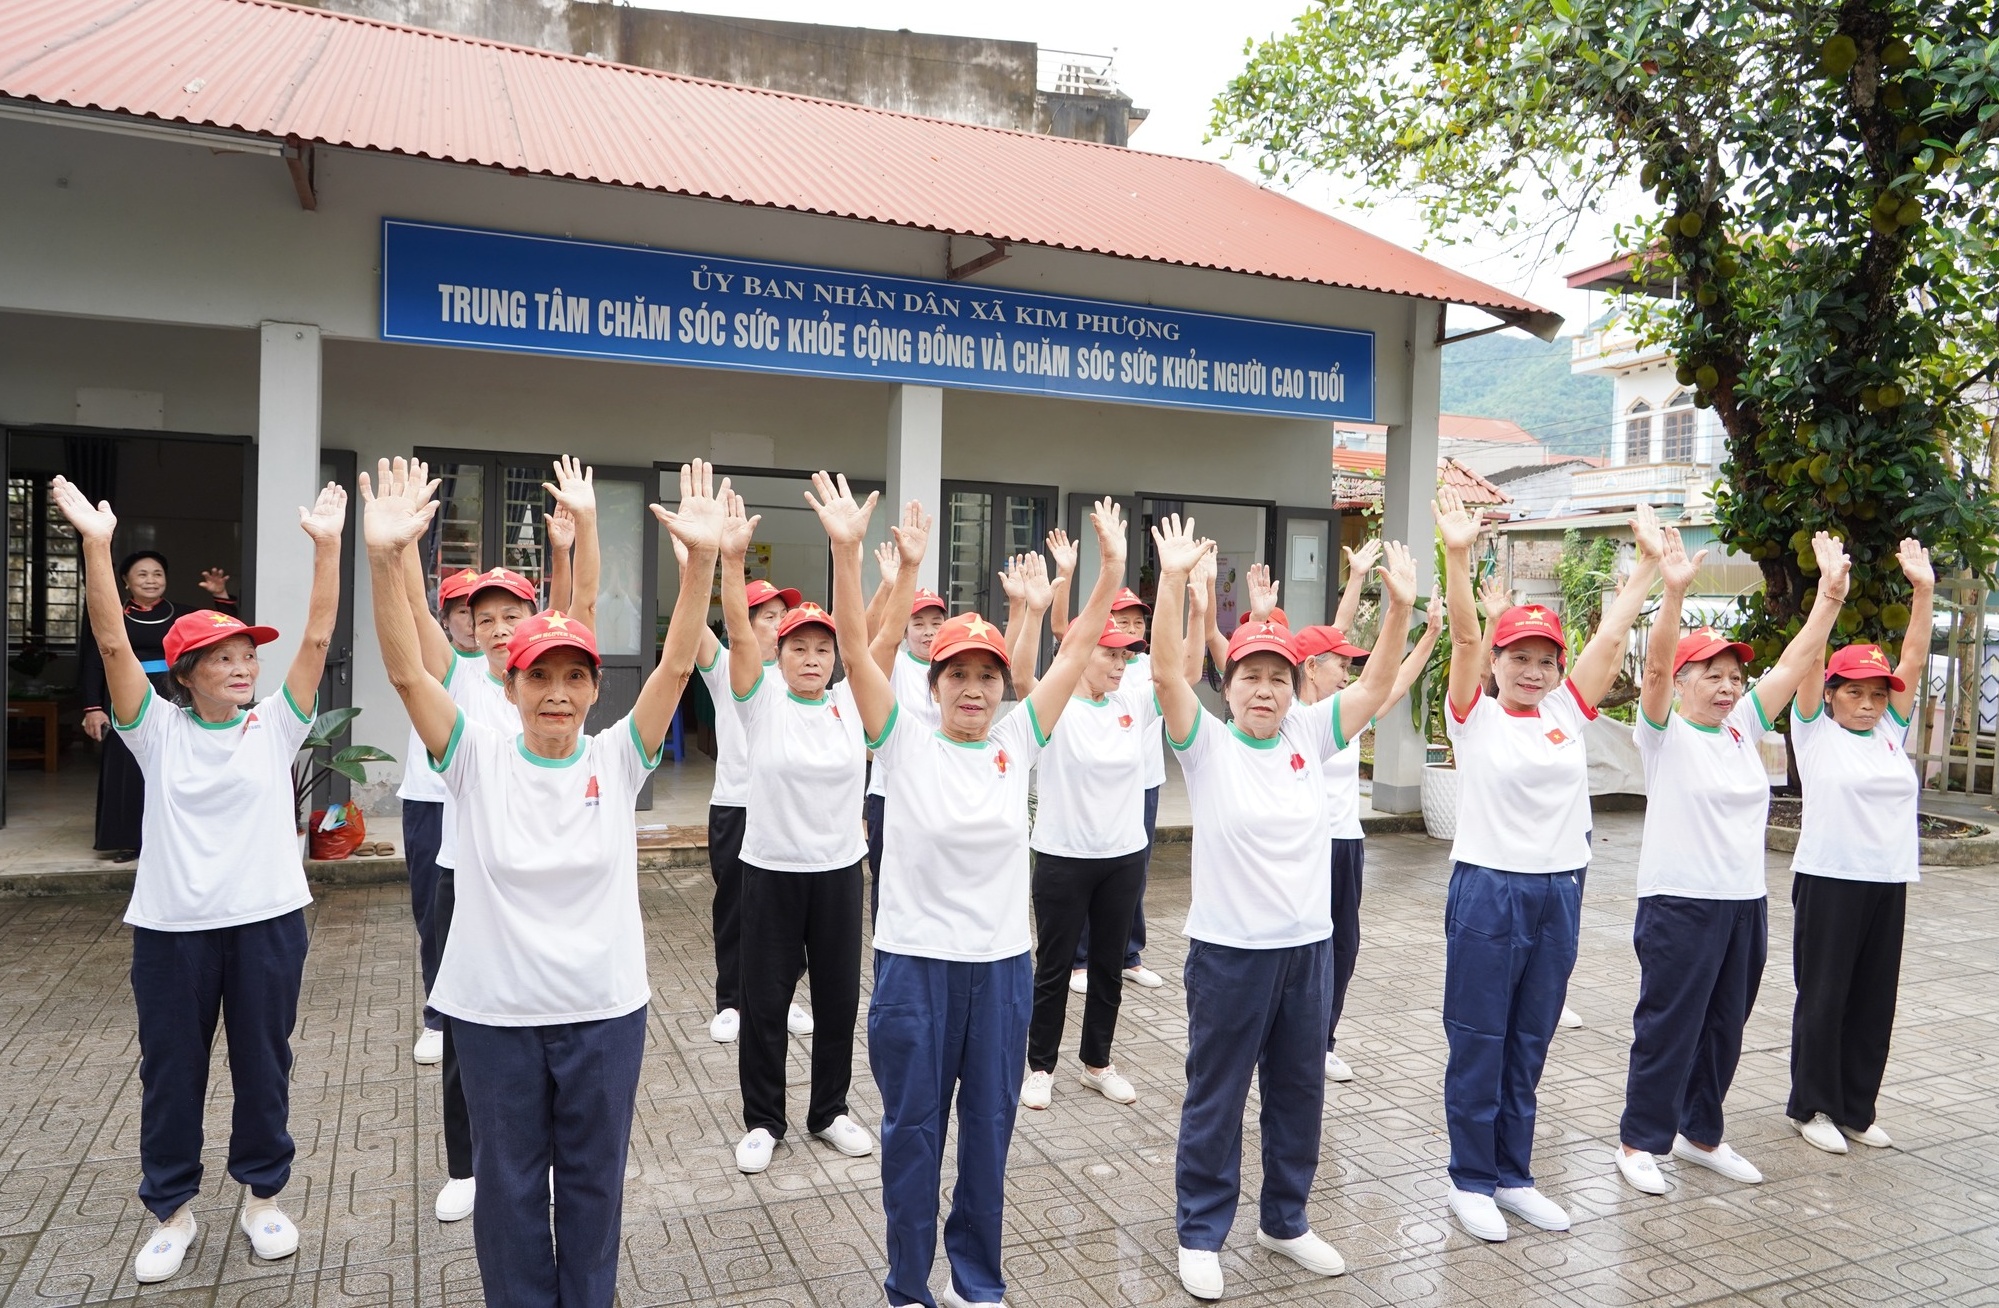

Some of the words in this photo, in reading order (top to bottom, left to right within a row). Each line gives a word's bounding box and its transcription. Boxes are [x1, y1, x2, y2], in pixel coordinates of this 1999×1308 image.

[438, 283, 527, 329] TRUNG
[534, 287, 590, 335] TÂM
[598, 296, 671, 342] CHĂM
[678, 302, 726, 347] SÓC
[733, 308, 780, 352] SỨC
[787, 309, 846, 357] KHỎE
[853, 318, 912, 367] CỘNG
[917, 323, 975, 369] ĐỒNG
[980, 332, 1008, 372] VÀ
[1012, 338, 1070, 379] CHĂM
[1076, 343, 1115, 382] SÓC
[1119, 347, 1157, 386] SỨC
[1162, 349, 1209, 391] KHỎE
[1213, 359, 1267, 396] NGƯỜI
[1271, 367, 1304, 400] CAO
[1308, 361, 1345, 403] TUỔI
[691, 265, 734, 293] ỦY
[744, 276, 805, 301] BAN
[813, 283, 896, 310] NHÂN
[903, 291, 960, 317] DÂN
[970, 299, 1006, 322] XÃ
[1016, 306, 1068, 329] KIM
[1076, 313, 1180, 342] PHƯỢNG
